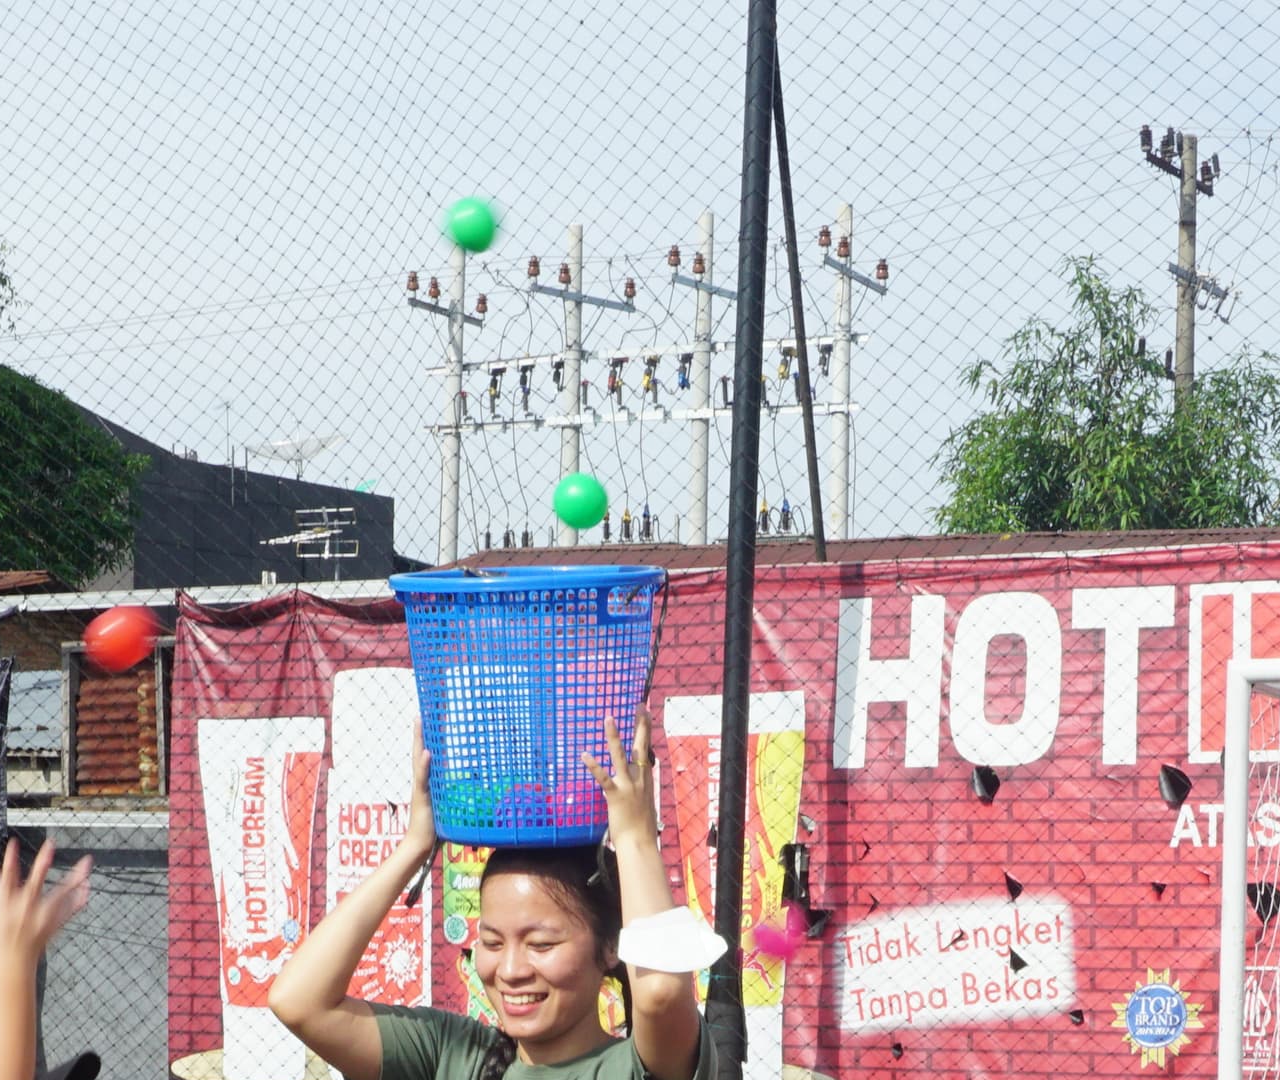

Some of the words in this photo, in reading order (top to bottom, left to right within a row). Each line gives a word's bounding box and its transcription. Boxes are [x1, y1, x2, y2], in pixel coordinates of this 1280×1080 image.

[338, 838, 402, 868] CREA
[840, 922, 922, 969] Tidak
[935, 908, 1065, 958] Lengket
[850, 984, 949, 1024] Tanpa
[960, 964, 1059, 1007] Bekas
[1135, 996, 1178, 1015] TOP
[1135, 1012, 1180, 1026] BRAND
